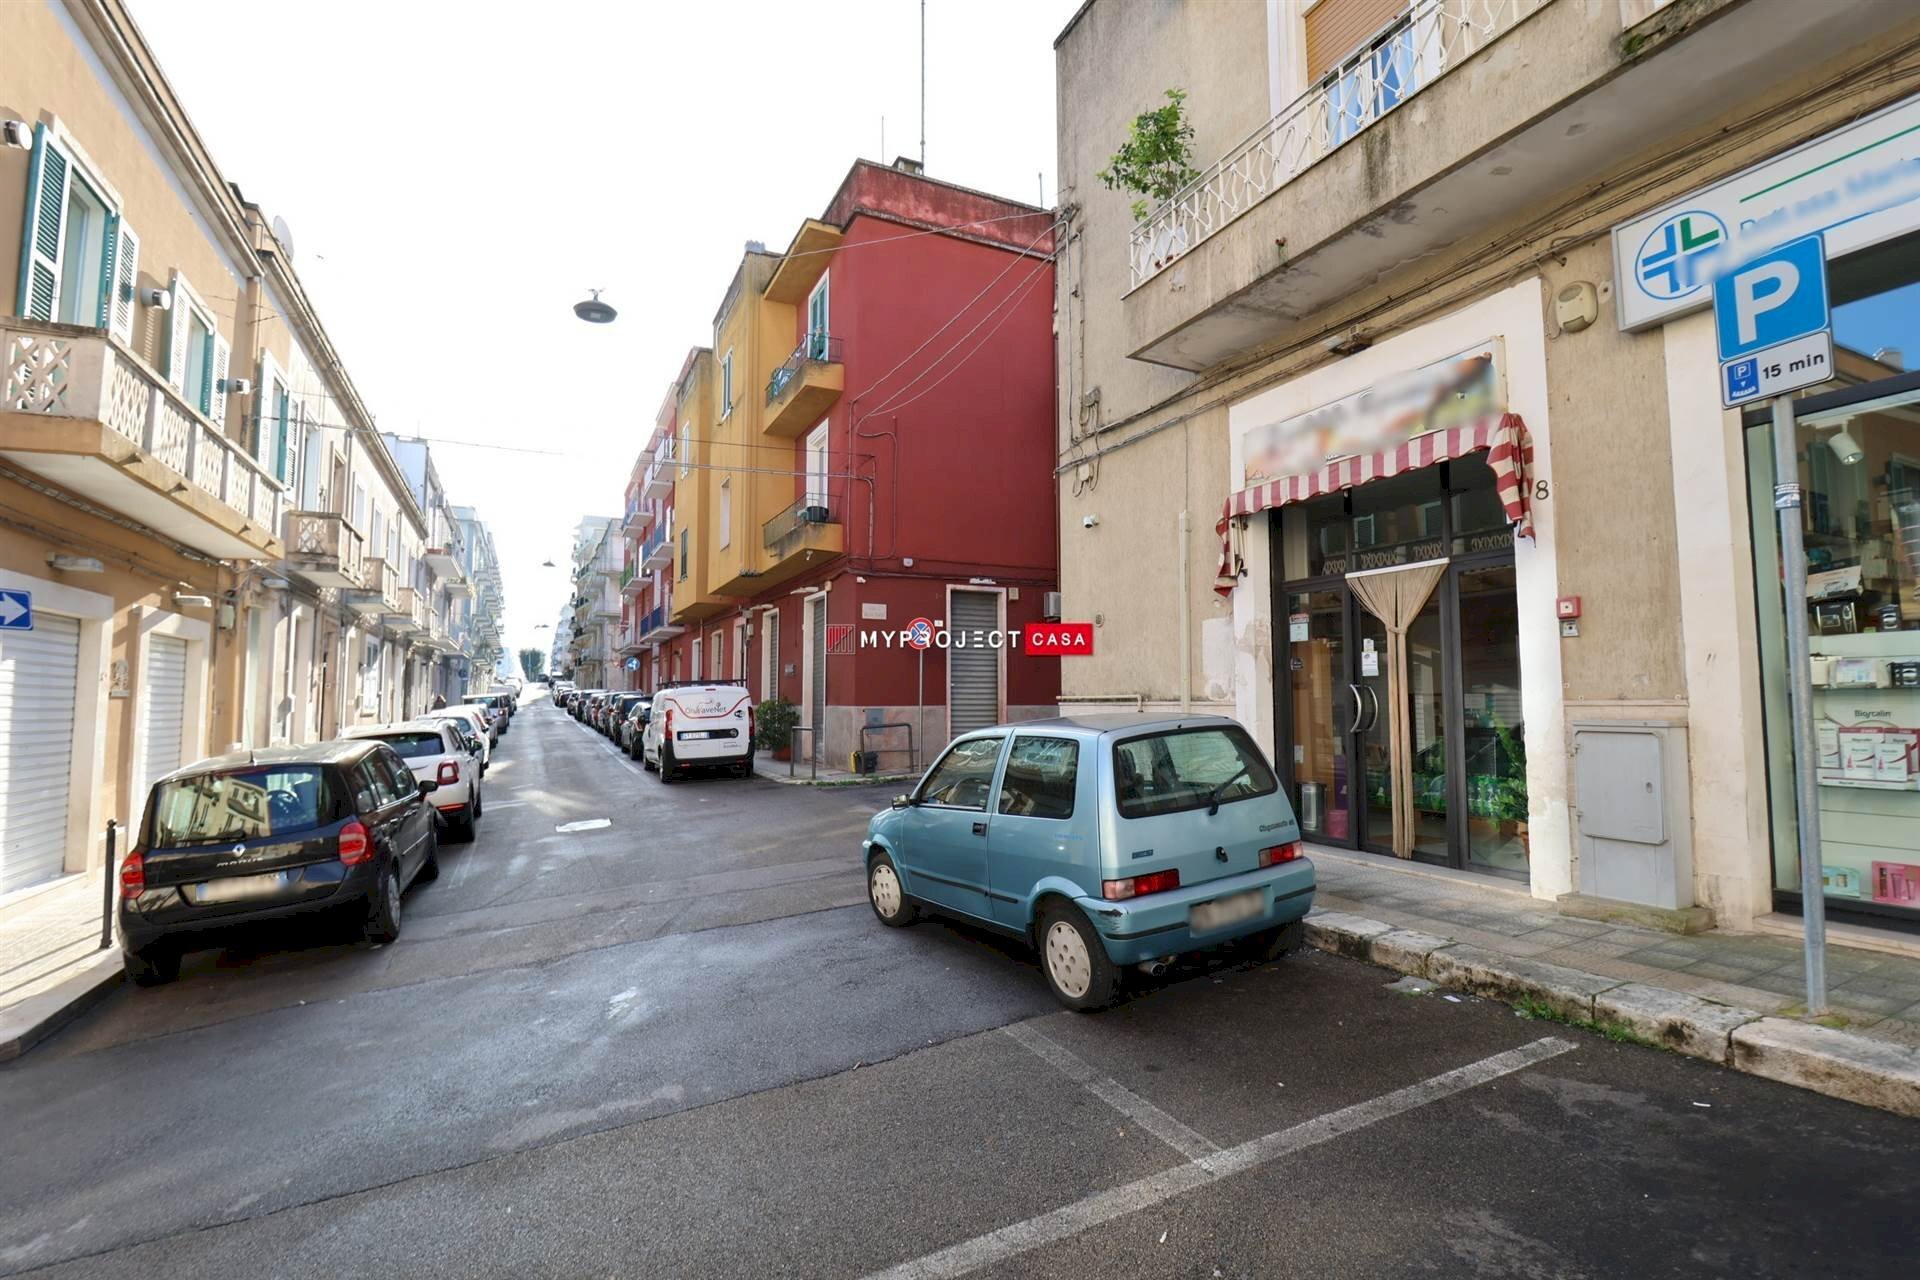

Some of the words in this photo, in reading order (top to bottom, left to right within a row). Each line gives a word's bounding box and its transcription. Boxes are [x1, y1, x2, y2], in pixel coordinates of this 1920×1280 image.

[1734, 260, 1799, 345] P
[1762, 364, 1782, 379] 15
[1789, 354, 1825, 372] min
[1536, 480, 1549, 500] 8
